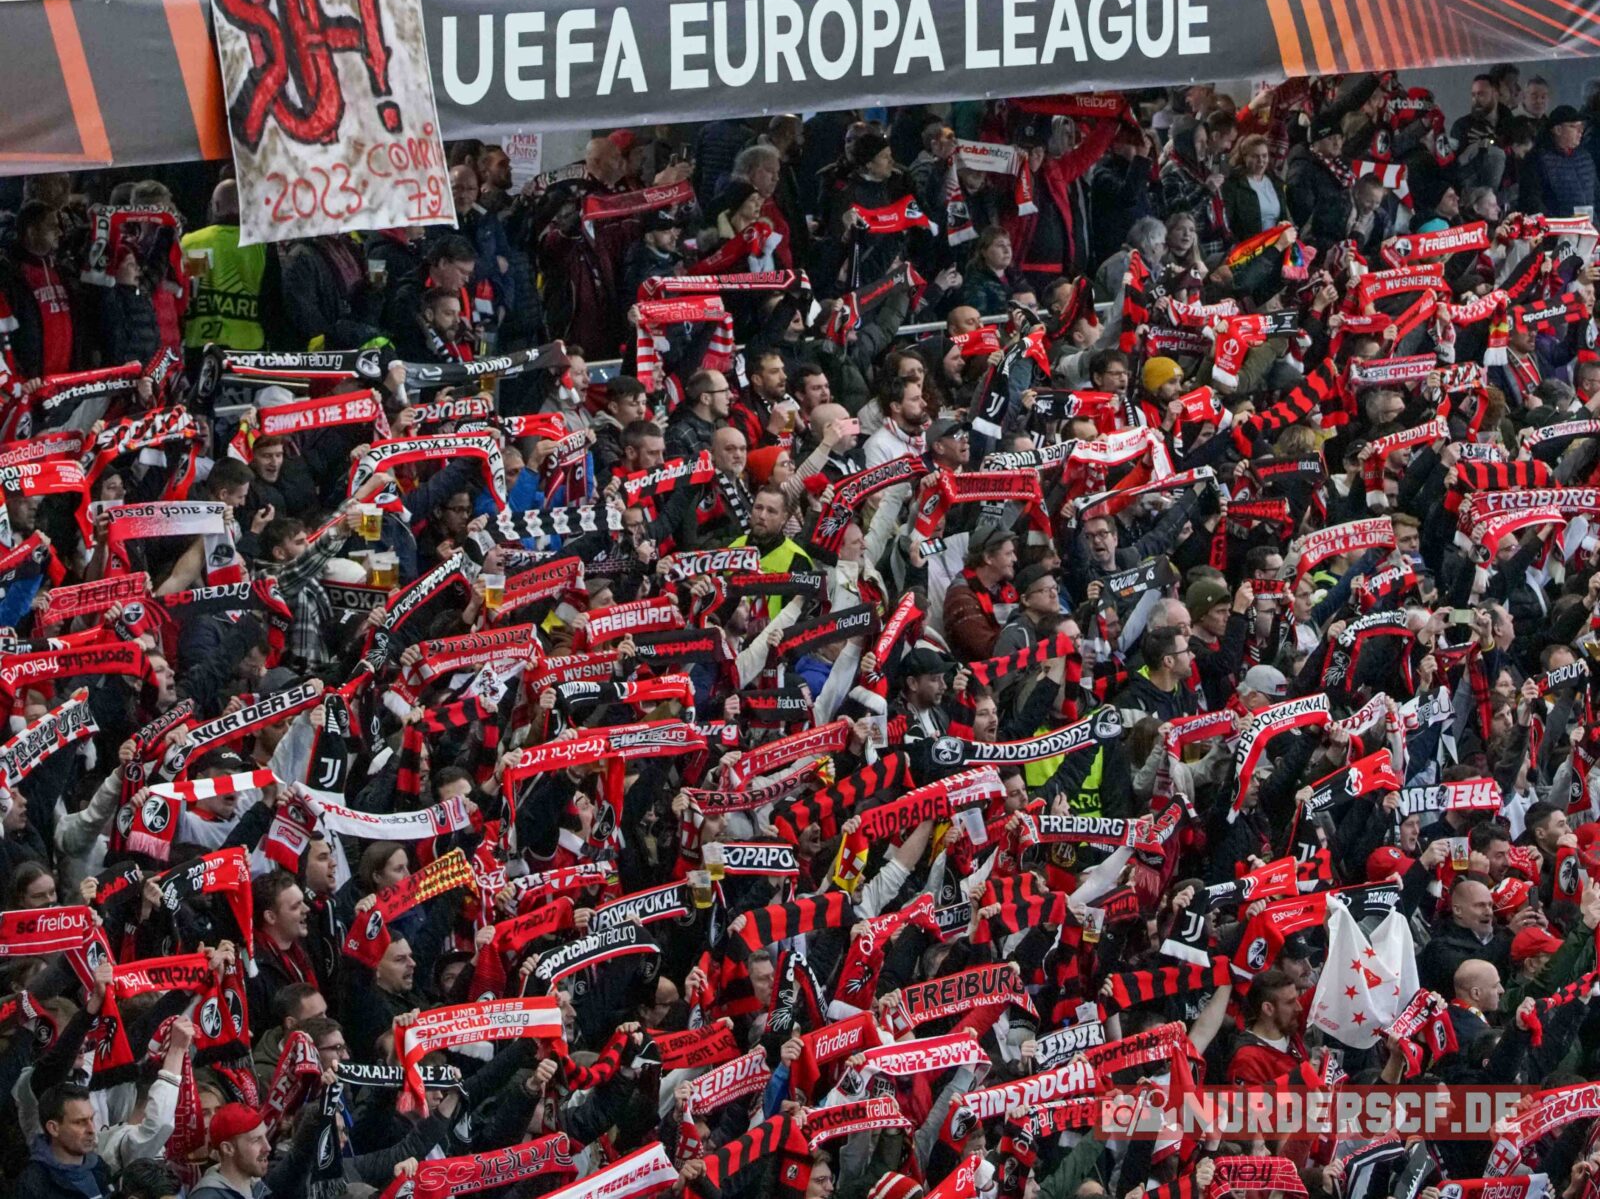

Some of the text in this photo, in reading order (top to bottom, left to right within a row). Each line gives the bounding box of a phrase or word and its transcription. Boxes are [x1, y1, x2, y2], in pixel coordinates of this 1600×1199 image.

[442, 5, 649, 106] UEFA
[1075, 95, 1117, 110] freiburg
[1424, 232, 1478, 254] FREIBURG
[1151, 285, 1167, 299] 16
[200, 321, 223, 342] 27
[464, 355, 513, 376] ROUND
[264, 412, 314, 433] SIMPLY
[318, 406, 343, 423] THE
[5, 475, 35, 492] OF 16
[160, 503, 200, 517] auch
[1486, 488, 1578, 513] FREIBURG
[1306, 529, 1394, 564] WALK ALONE
[1109, 572, 1140, 590] ROUND
[609, 600, 652, 614] SPORTCLUB
[590, 606, 673, 634] FREIBURG
[1, 647, 135, 685] sportclubfreiburg
[191, 714, 239, 745] NUR
[240, 695, 284, 722] DER
[972, 723, 1092, 758] EUROPAPOKAL
[1039, 814, 1125, 837] FREIBURG
[535, 925, 637, 980] sportclubfreiburg
[906, 966, 1026, 1015] FREIBURG
[416, 1001, 524, 1026] ROT UND WEISS
[944, 1000, 971, 1015] NEVER
[973, 995, 1000, 1008] WALK
[415, 1012, 530, 1040] sportclubfreiburg
[421, 1026, 524, 1052] EIN LEBEN LANG
[816, 1026, 863, 1059] förderer
[450, 1163, 545, 1196] HEIA HEIA SCF
